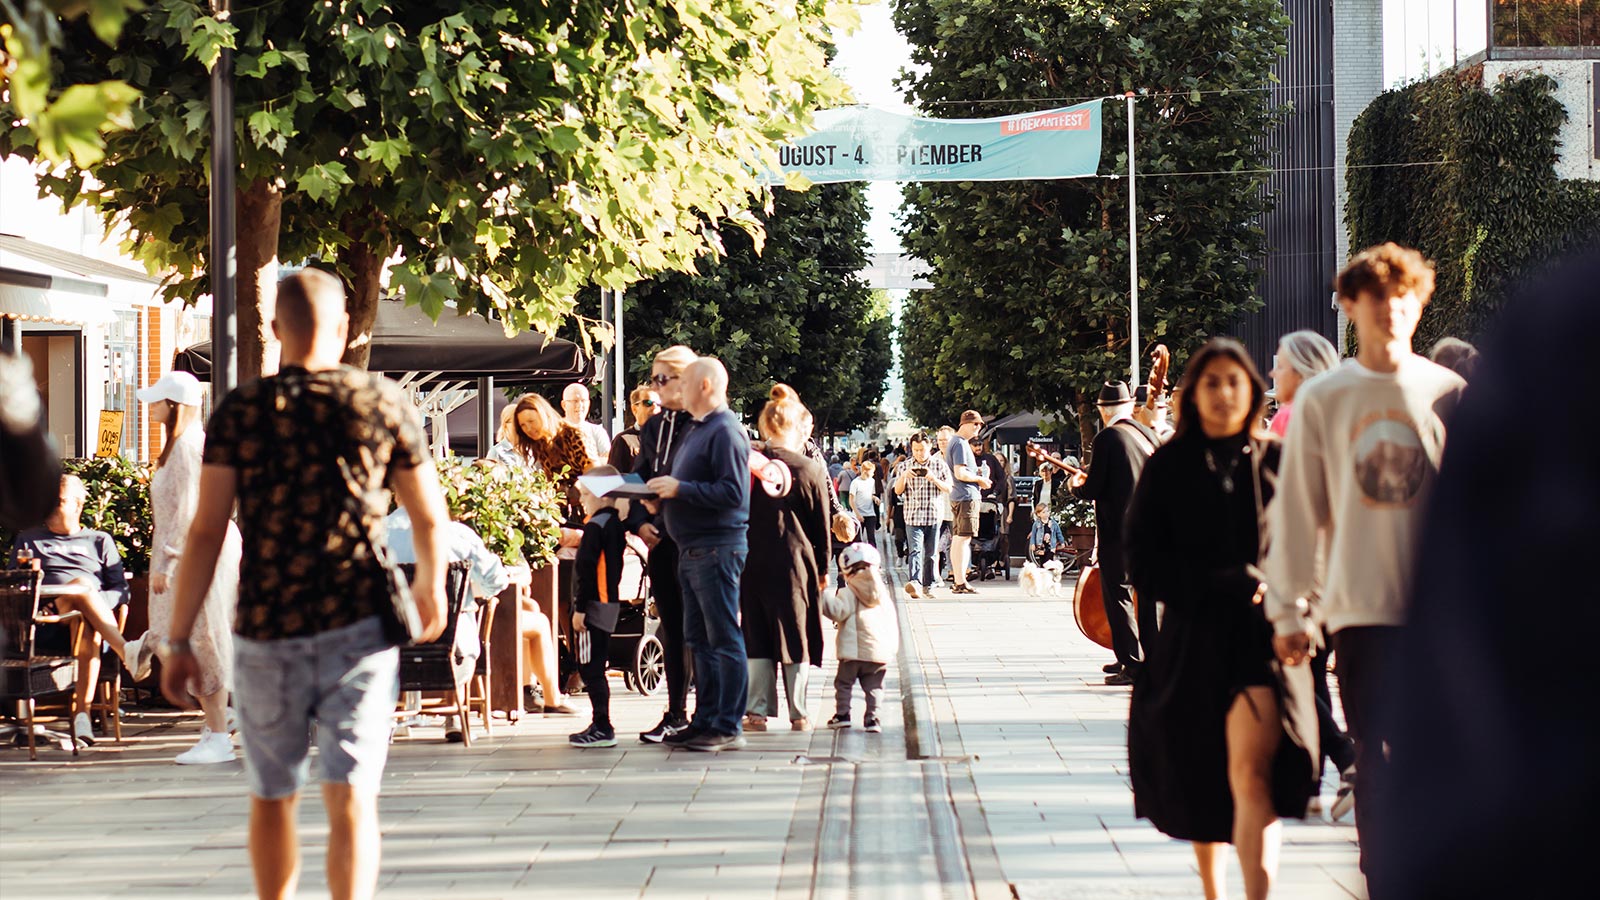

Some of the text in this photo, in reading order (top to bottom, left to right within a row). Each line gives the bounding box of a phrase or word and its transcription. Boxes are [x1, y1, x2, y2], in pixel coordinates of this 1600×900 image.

[1007, 113, 1084, 131] #TREKANTFEST
[779, 145, 838, 167] UGUST
[854, 145, 870, 165] 4.
[875, 144, 983, 166] SEPTEMBER
